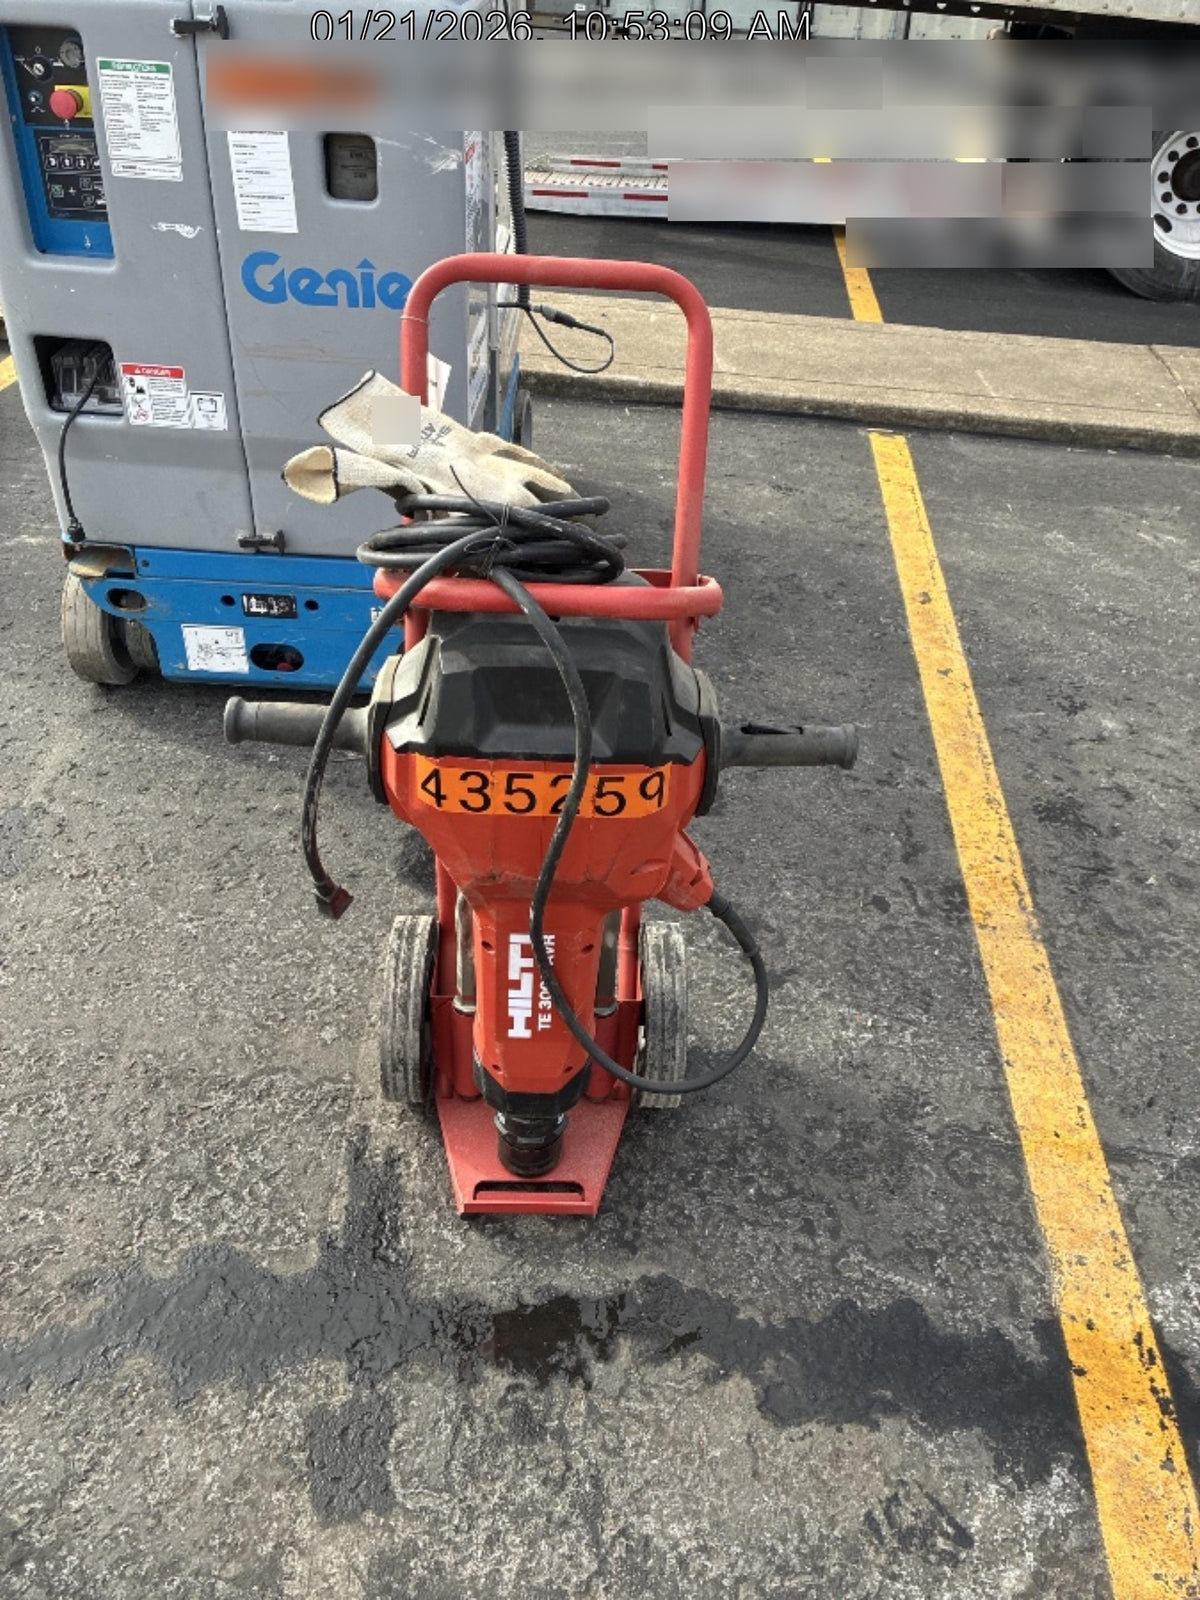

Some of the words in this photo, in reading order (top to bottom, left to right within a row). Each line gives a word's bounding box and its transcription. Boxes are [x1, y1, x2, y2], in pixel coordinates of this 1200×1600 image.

[241, 250, 413, 310] Genie
[420, 768, 666, 817] 435259
[507, 933, 534, 1038] HILTI
[538, 1012, 552, 1031] TE
